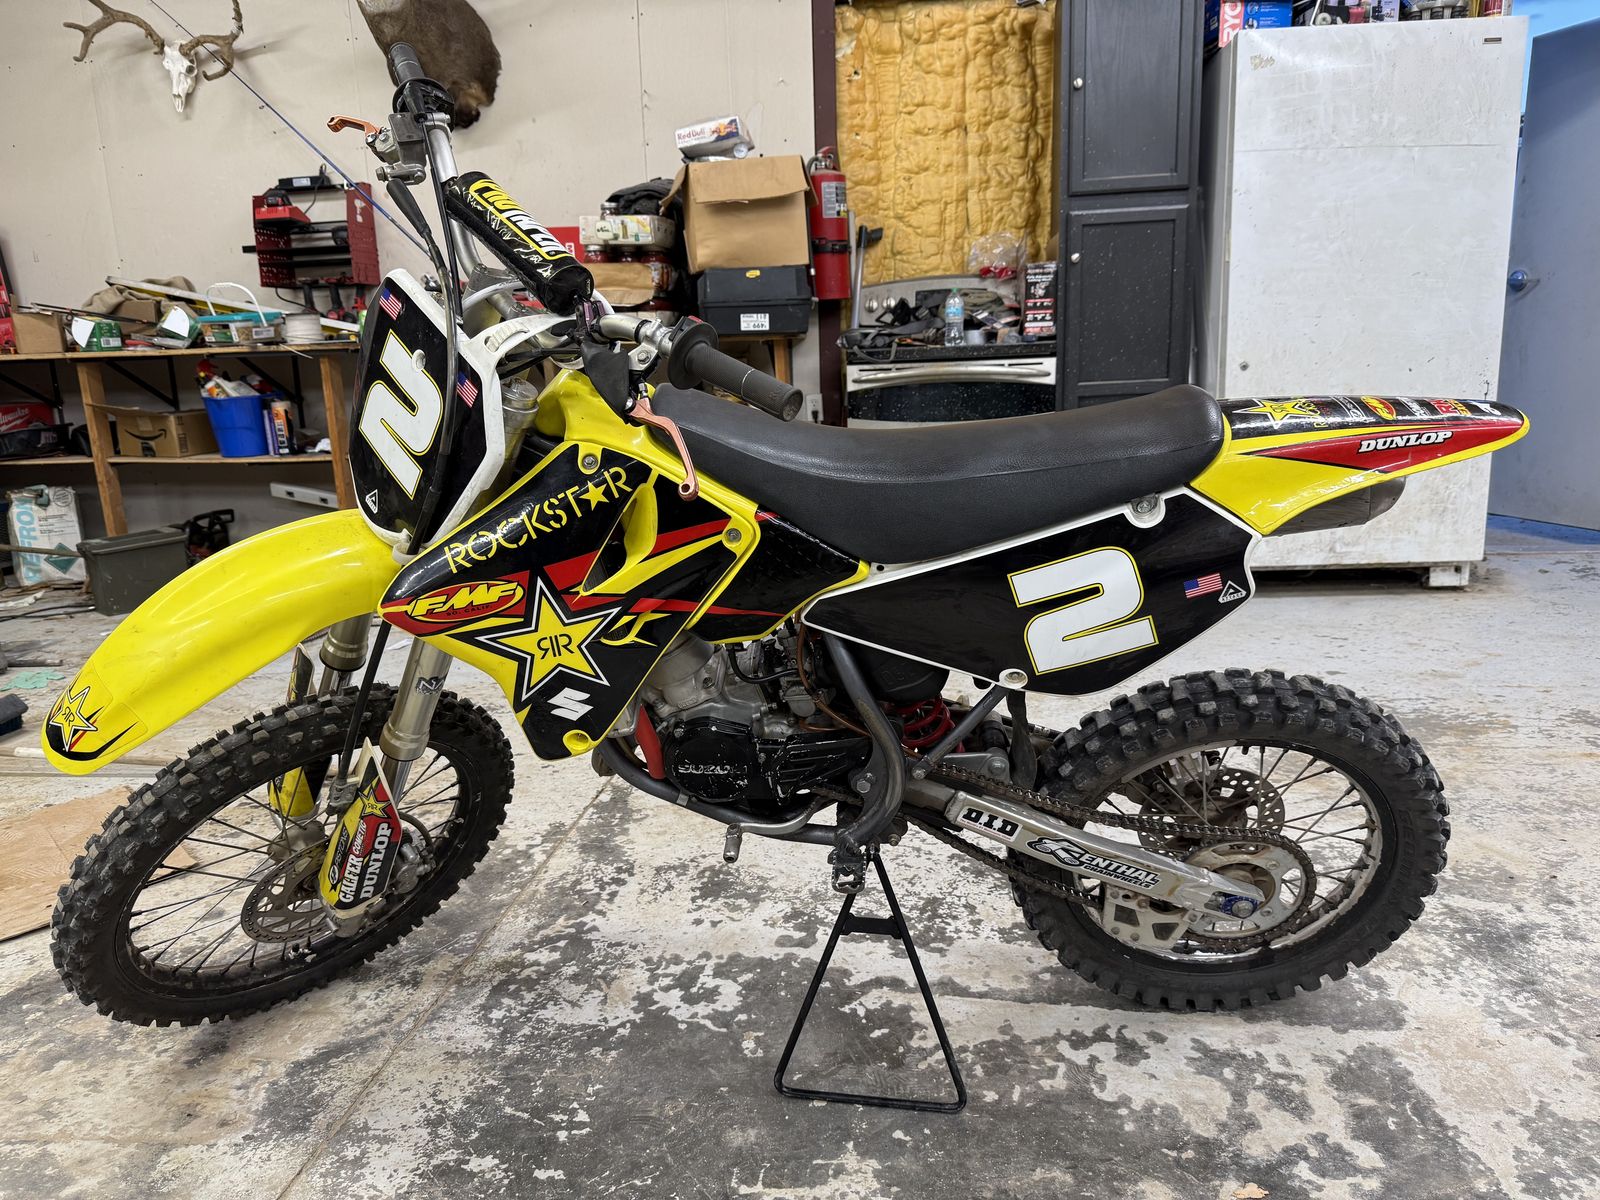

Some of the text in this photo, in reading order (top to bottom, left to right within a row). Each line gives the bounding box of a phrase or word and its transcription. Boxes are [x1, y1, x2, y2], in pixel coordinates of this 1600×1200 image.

[359, 328, 443, 500] 2
[1357, 431, 1453, 454] DUNLOP
[410, 582, 518, 617] FMF
[1007, 546, 1159, 675] 2
[339, 854, 363, 902] GALFER
[360, 823, 392, 898] DUNLOP
[1084, 864, 1153, 889] CHAINWHEELS
